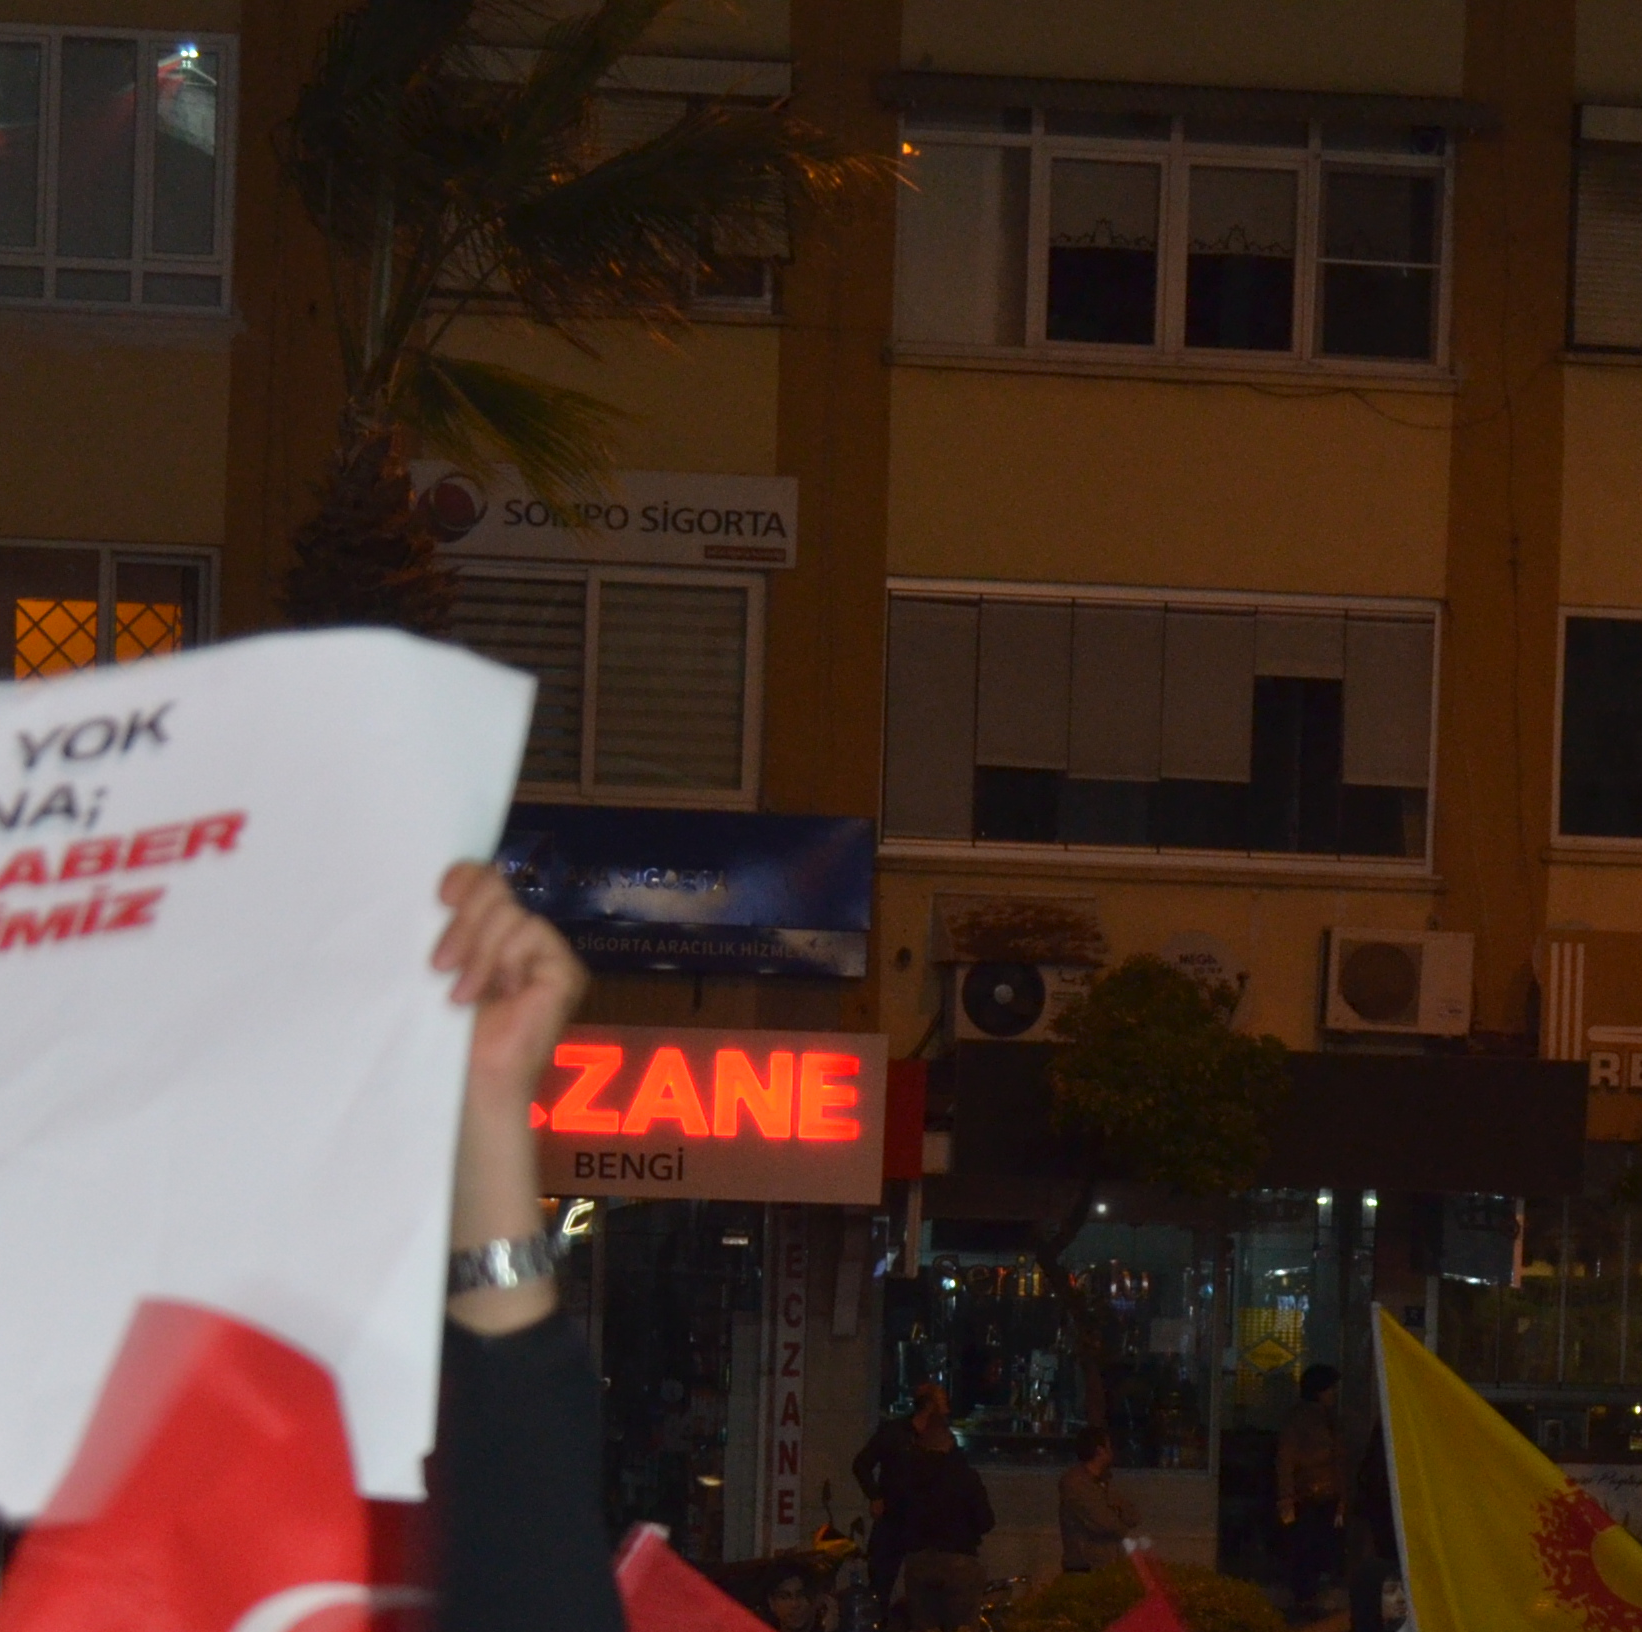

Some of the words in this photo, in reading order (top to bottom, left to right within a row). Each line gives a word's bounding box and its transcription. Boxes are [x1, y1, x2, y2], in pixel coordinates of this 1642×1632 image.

[641, 500, 787, 538] SİGORTA
[13, 700, 178, 771] YOK
[529, 1043, 861, 1141] ZANE
[574, 1148, 685, 1182] BENGİ
[776, 1243, 804, 1526] ECZANE
